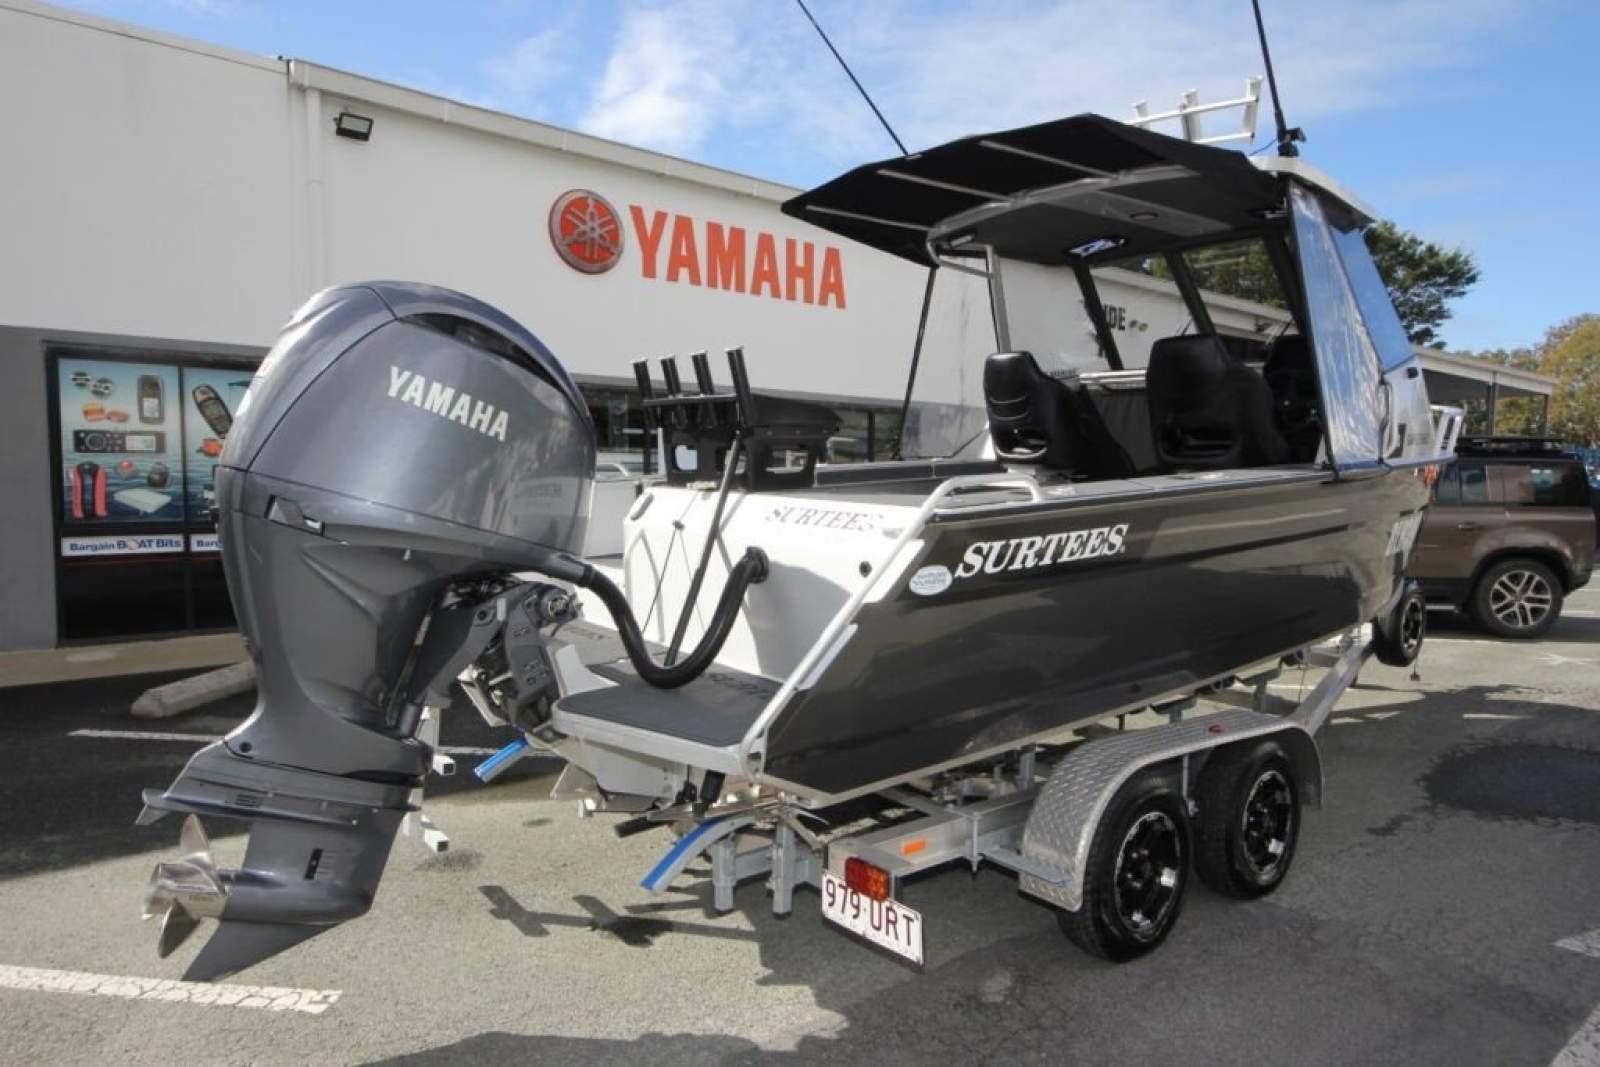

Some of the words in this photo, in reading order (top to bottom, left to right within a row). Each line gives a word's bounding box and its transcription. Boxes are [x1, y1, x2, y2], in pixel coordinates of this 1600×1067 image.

[629, 204, 846, 309] YAMAHA
[387, 366, 509, 442] YAMAHA
[69, 542, 115, 552] Bargain
[156, 538, 182, 549] Bits
[954, 524, 1129, 579] SURTEES
[826, 879, 860, 919] 979
